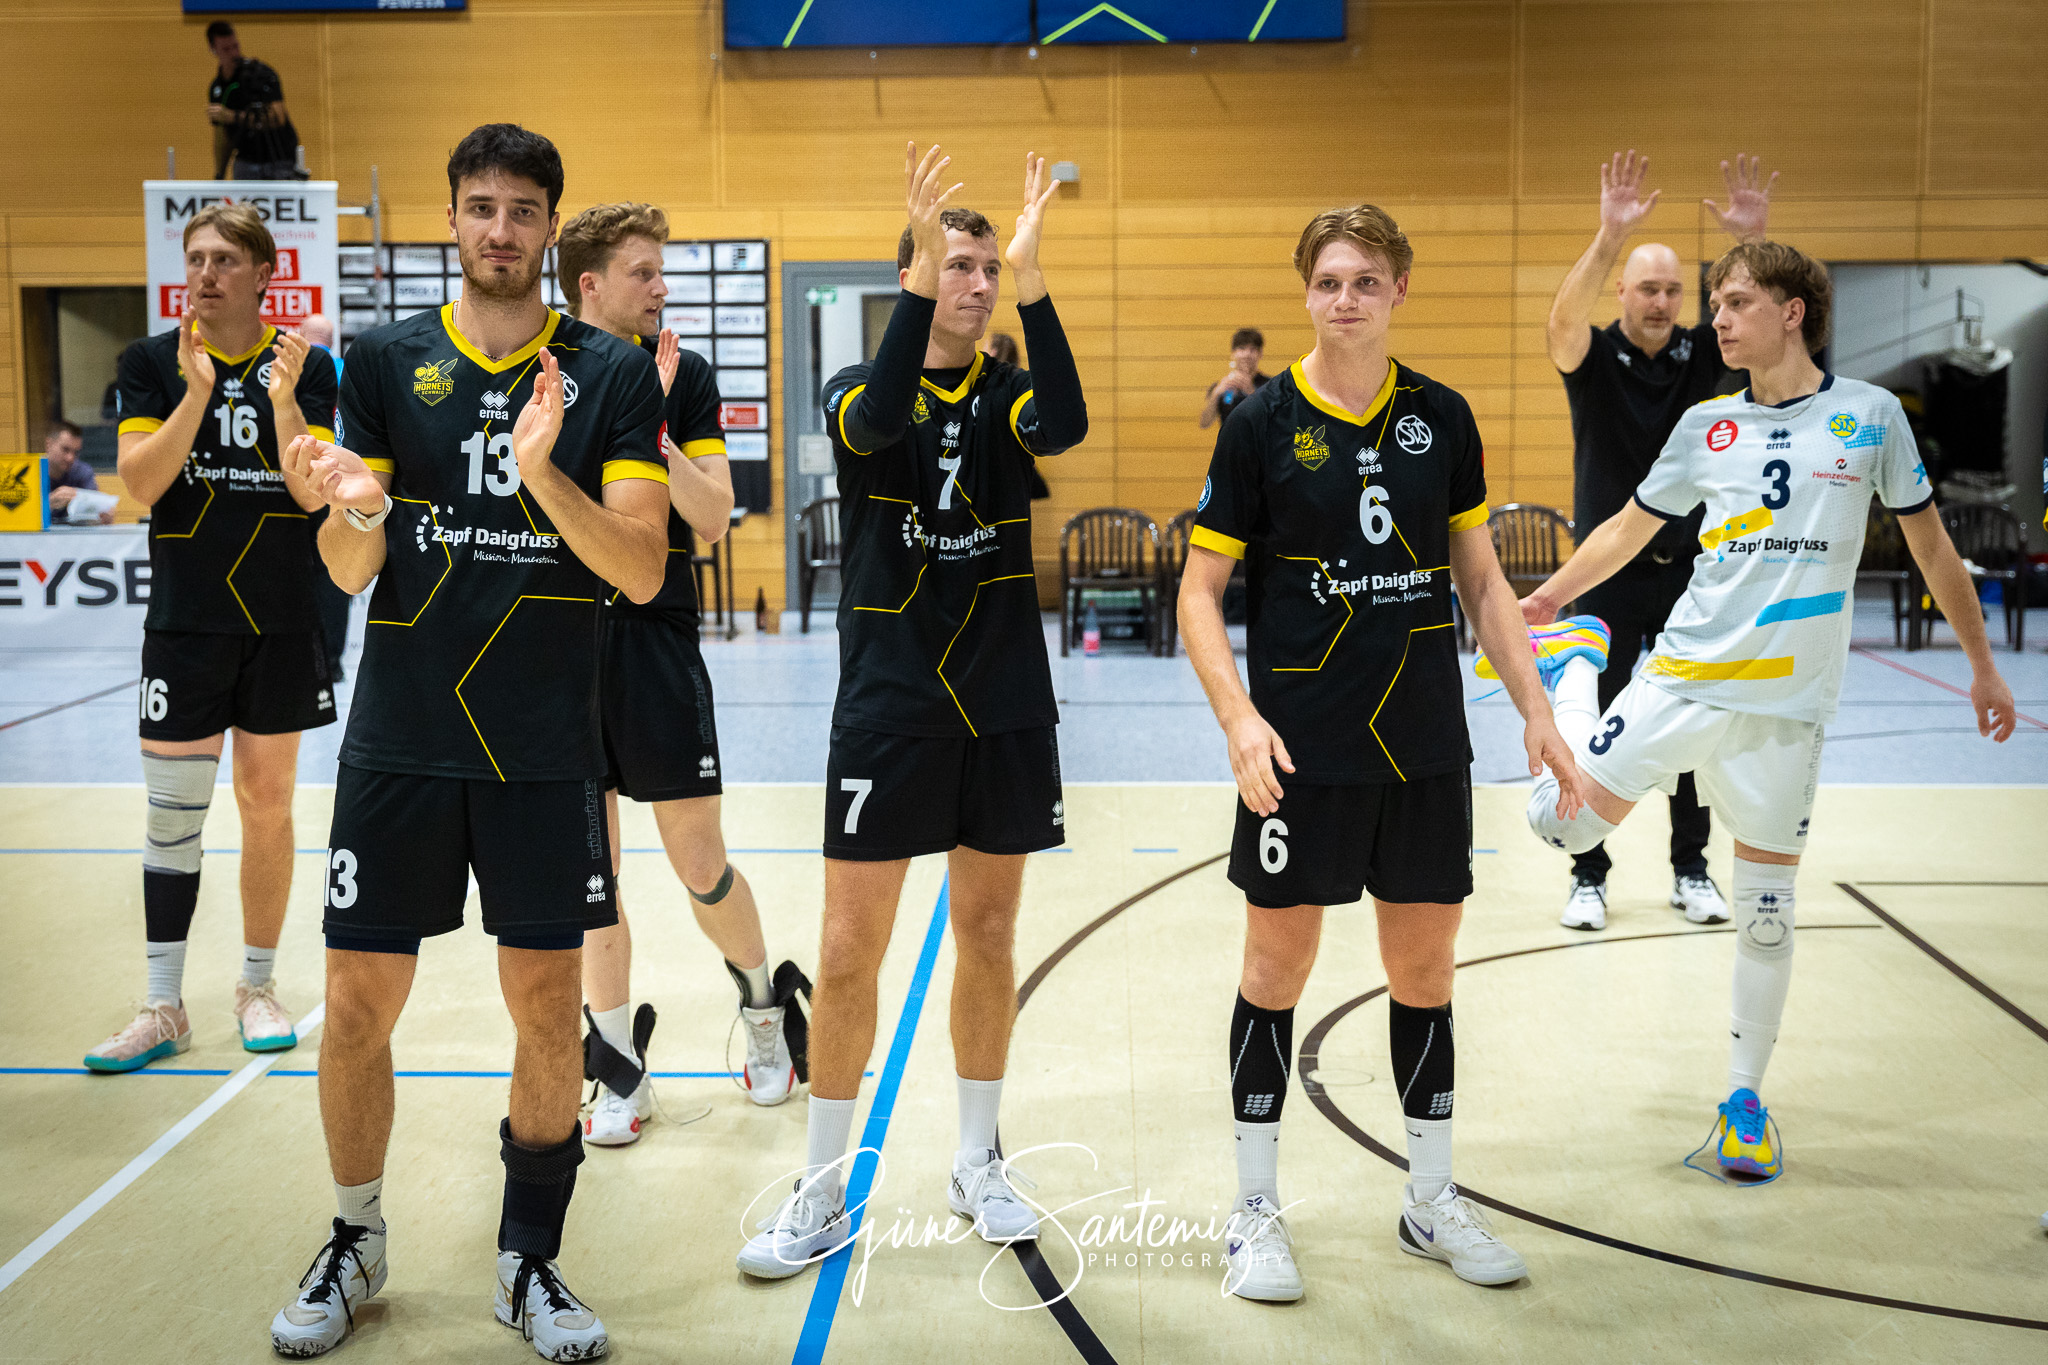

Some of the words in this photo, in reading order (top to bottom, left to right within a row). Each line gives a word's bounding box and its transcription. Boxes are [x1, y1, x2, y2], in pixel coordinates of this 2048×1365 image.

[415, 382, 451, 392] HORNETS
[479, 409, 509, 421] errea
[214, 403, 259, 449] 16
[1296, 447, 1328, 458] HORNETS
[1766, 441, 1791, 450] errea
[194, 464, 228, 481] Zapf
[461, 431, 523, 497] 13
[1357, 463, 1383, 476] errea
[938, 455, 962, 510] 7
[1761, 459, 1791, 510] 3
[1812, 471, 1862, 483] Heinzelmann
[1359, 485, 1393, 545] 6
[431, 525, 473, 545] Zapf
[475, 527, 560, 551] Daigfuss
[1728, 539, 1762, 556] Zapf
[1764, 537, 1829, 554] Daigfuss
[1327, 575, 1369, 596] Zapf
[140, 676, 169, 722] 16
[1588, 714, 1625, 756] 3
[840, 778, 873, 834] 7
[1259, 817, 1289, 874] 6
[586, 891, 606, 903] errea
[1243, 1107, 1270, 1116] cep
[1428, 1106, 1451, 1115] cep
